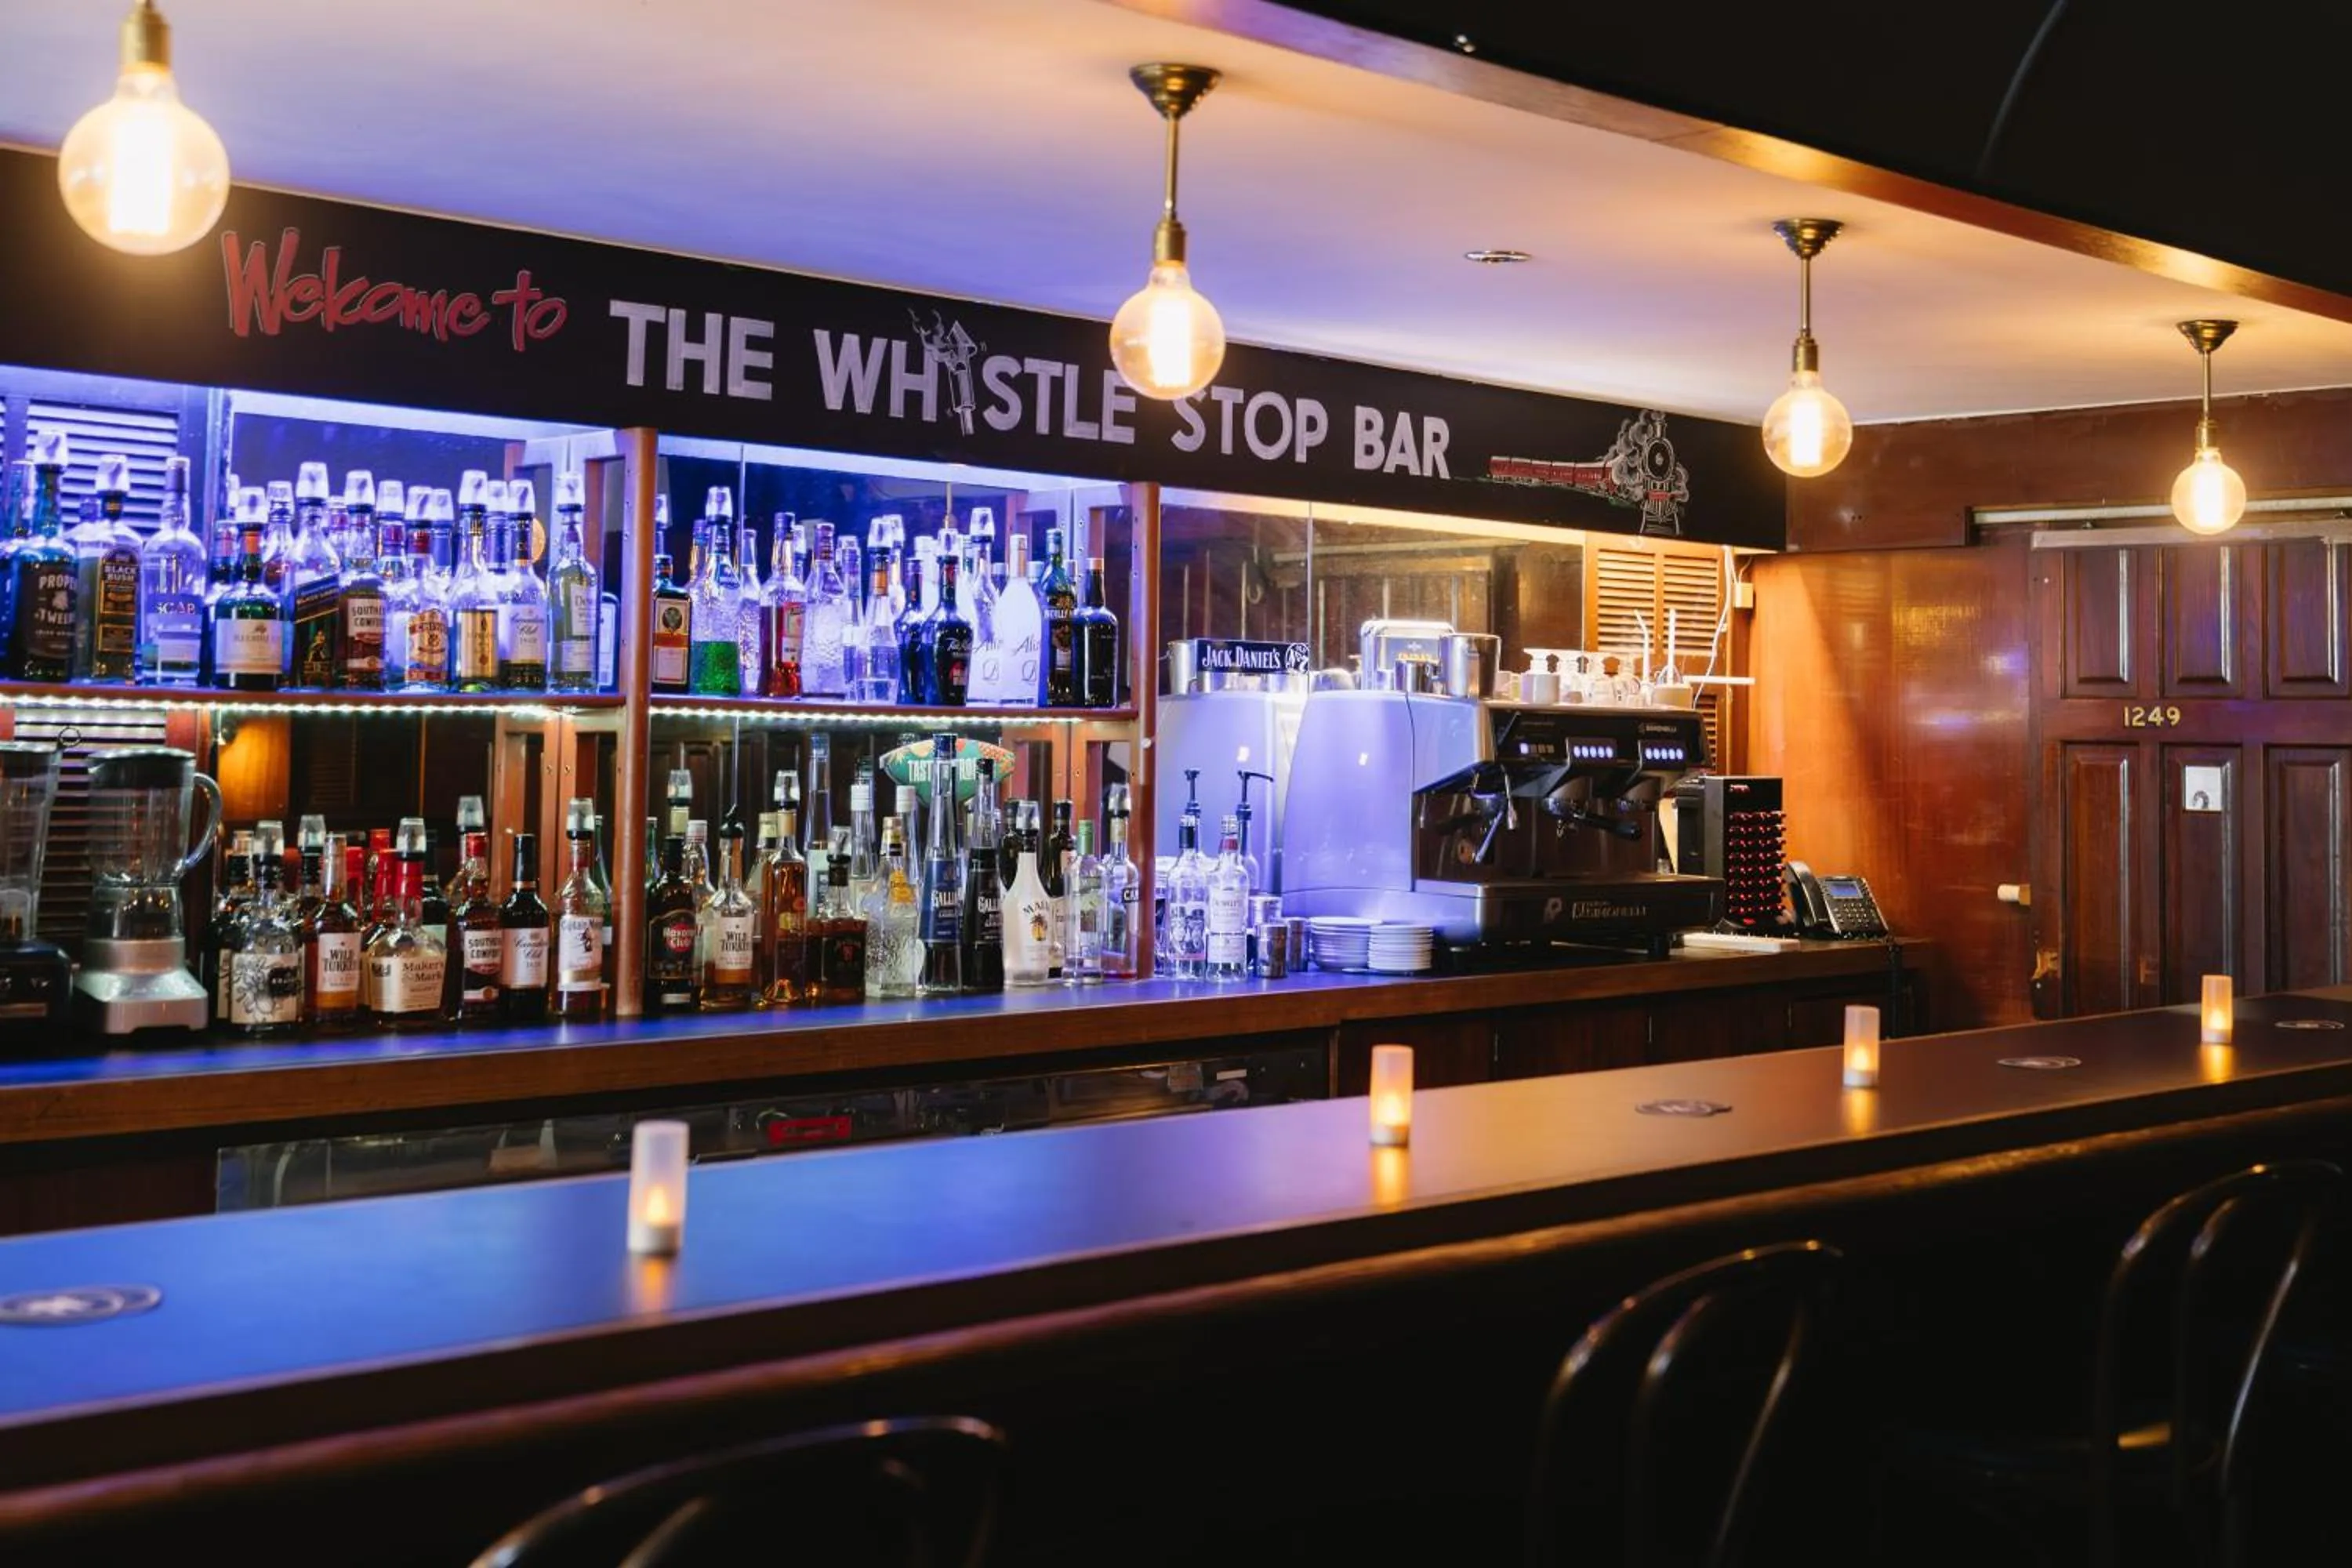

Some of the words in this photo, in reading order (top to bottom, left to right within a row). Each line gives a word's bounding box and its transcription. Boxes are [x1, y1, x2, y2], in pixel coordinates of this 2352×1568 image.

[220, 227, 491, 342] Welcome
[492, 270, 567, 352] to
[609, 299, 775, 401] THE
[1171, 385, 1329, 463] STOP
[1353, 405, 1451, 481] BAR
[38, 573, 78, 590] PROPE
[1202, 644, 1233, 668] JACK
[1235, 645, 1281, 670] DANIEL'S
[2123, 706, 2182, 728] 1249
